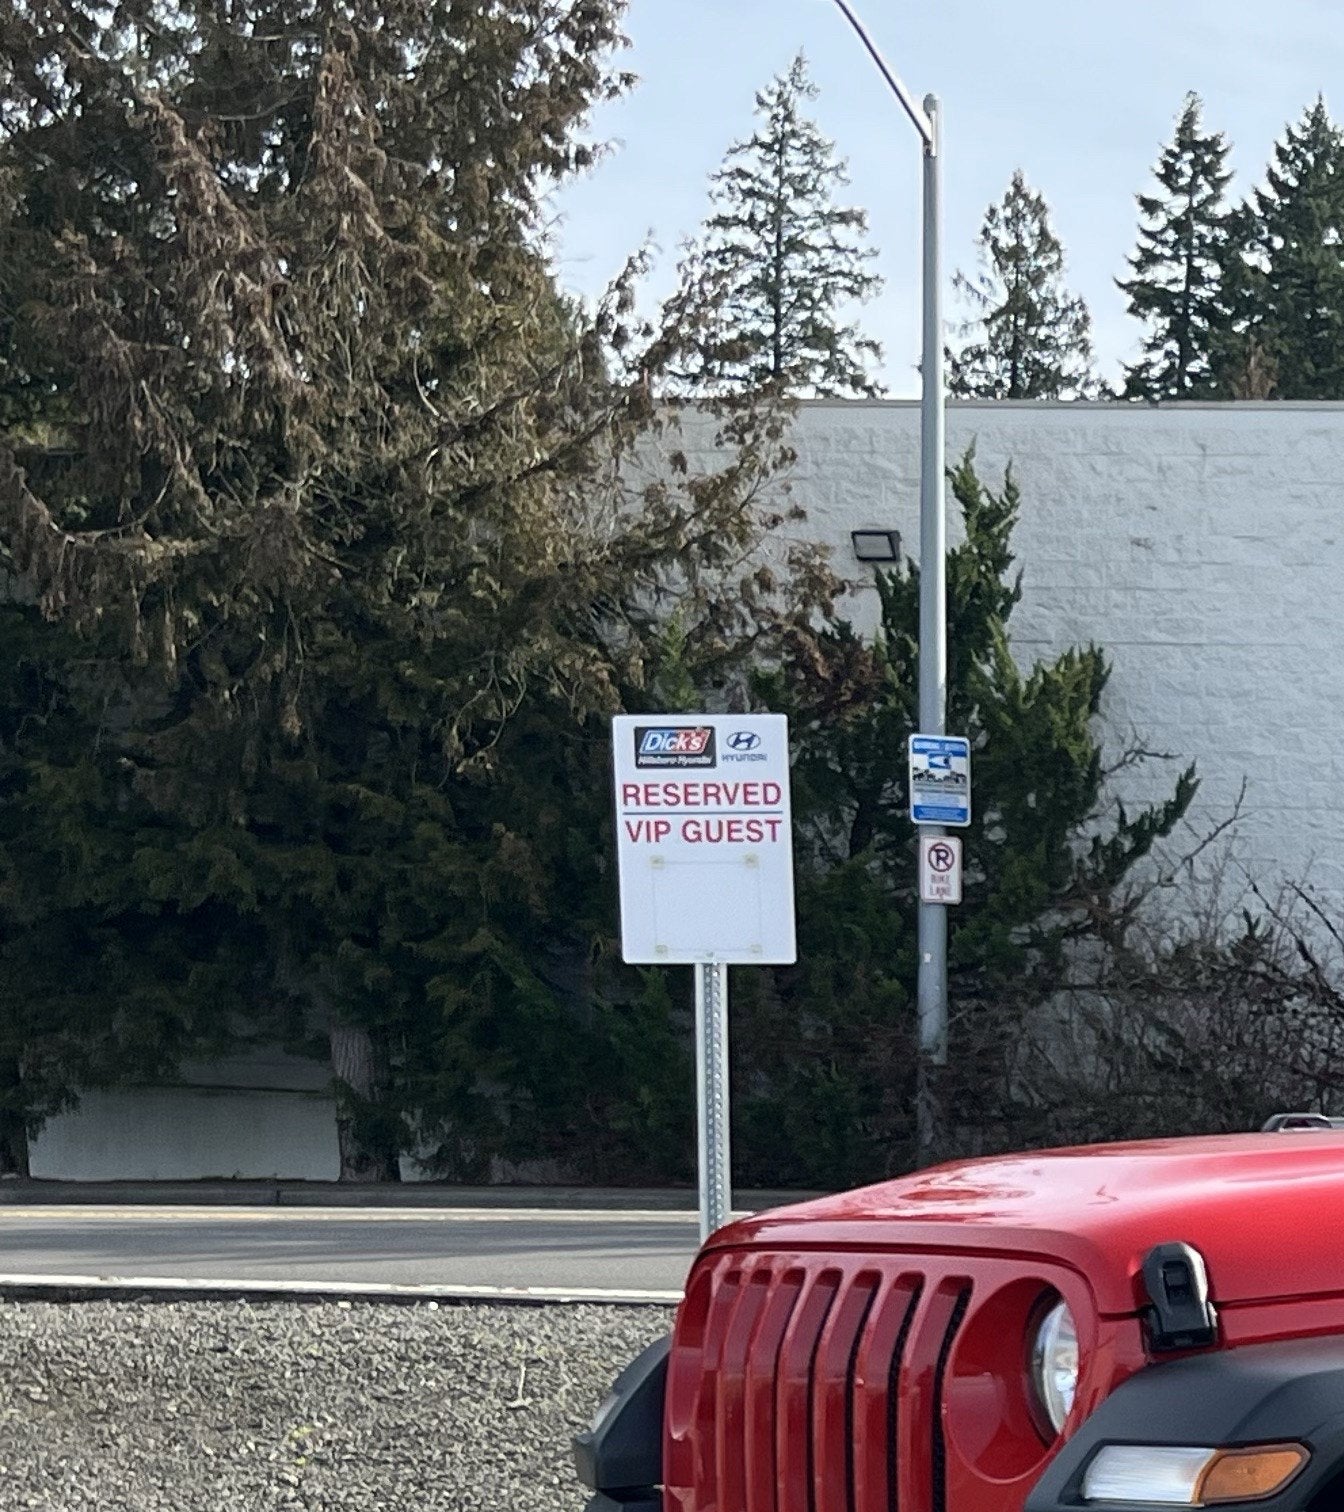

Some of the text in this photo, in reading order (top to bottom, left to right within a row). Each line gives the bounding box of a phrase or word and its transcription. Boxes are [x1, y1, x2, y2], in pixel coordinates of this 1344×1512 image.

[622, 782, 783, 807] RESERVED
[624, 819, 783, 844] VIP GUEST
